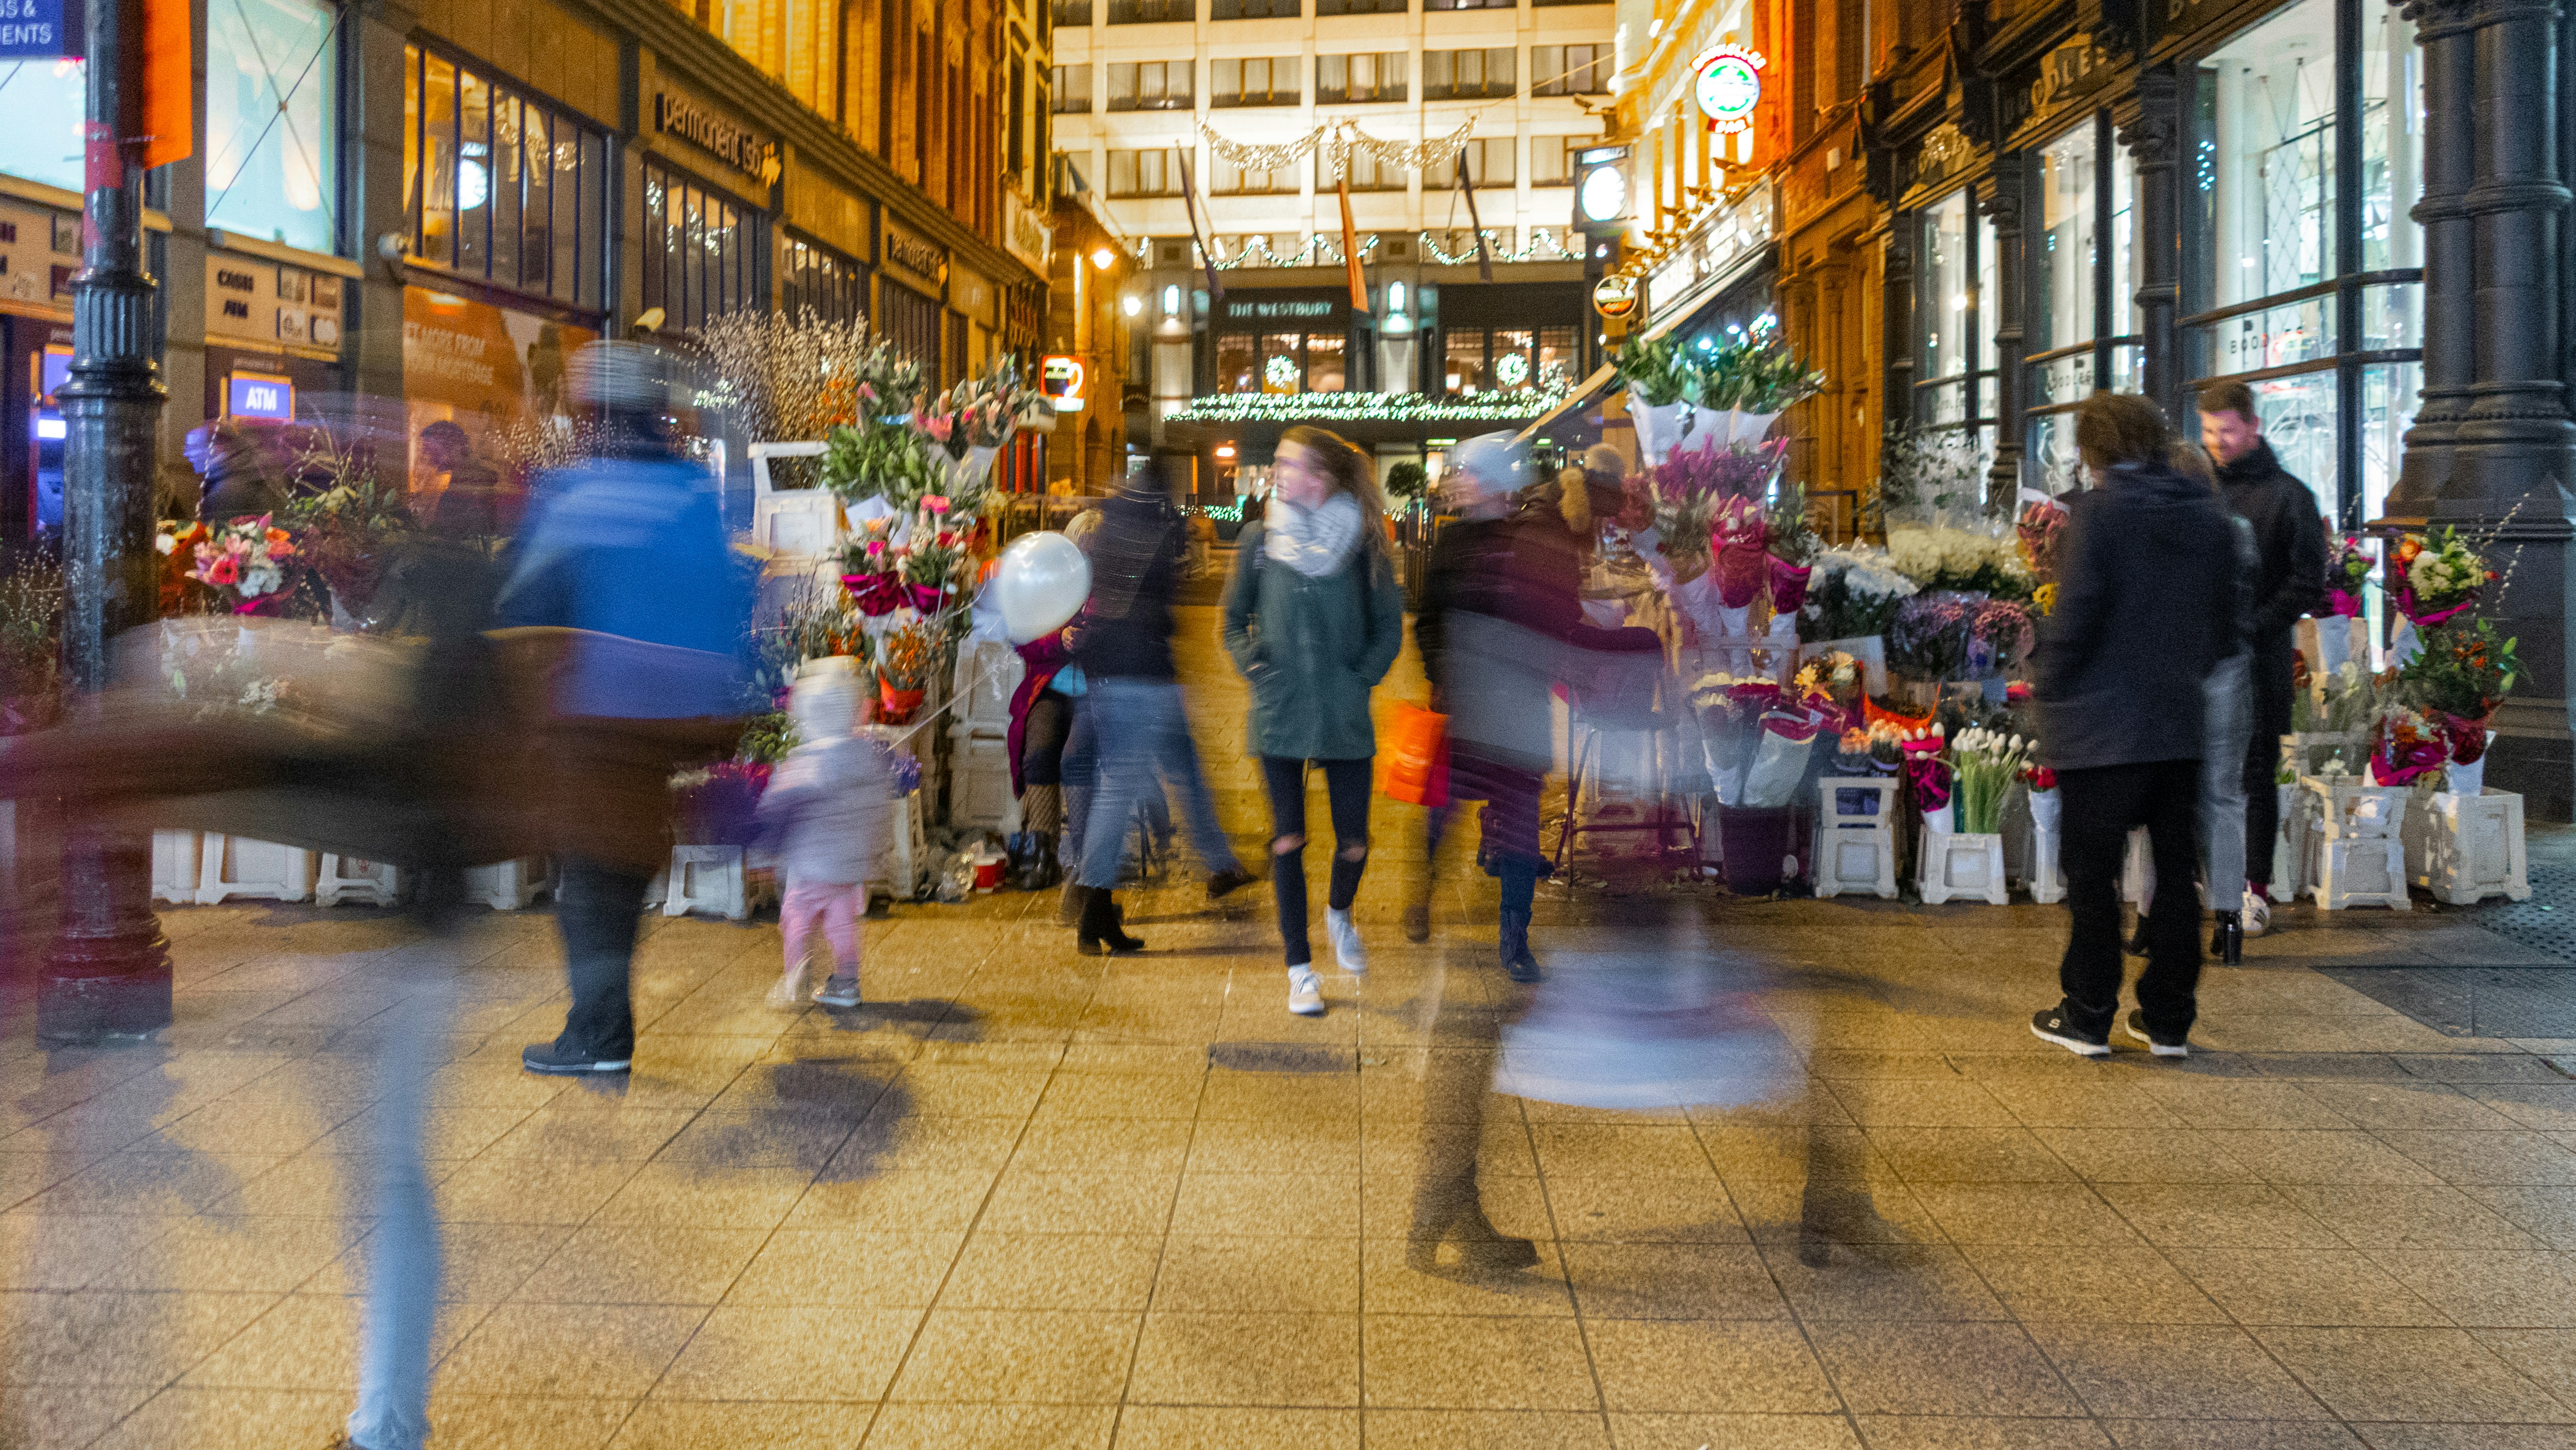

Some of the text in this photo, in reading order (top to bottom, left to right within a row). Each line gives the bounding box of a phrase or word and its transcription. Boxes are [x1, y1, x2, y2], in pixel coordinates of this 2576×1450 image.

[24, 0, 36, 17] &
[0, 24, 52, 45] ENTS
[2003, 46, 2107, 125] OODLES
[404, 322, 420, 345] ET
[245, 386, 277, 411] ATM
